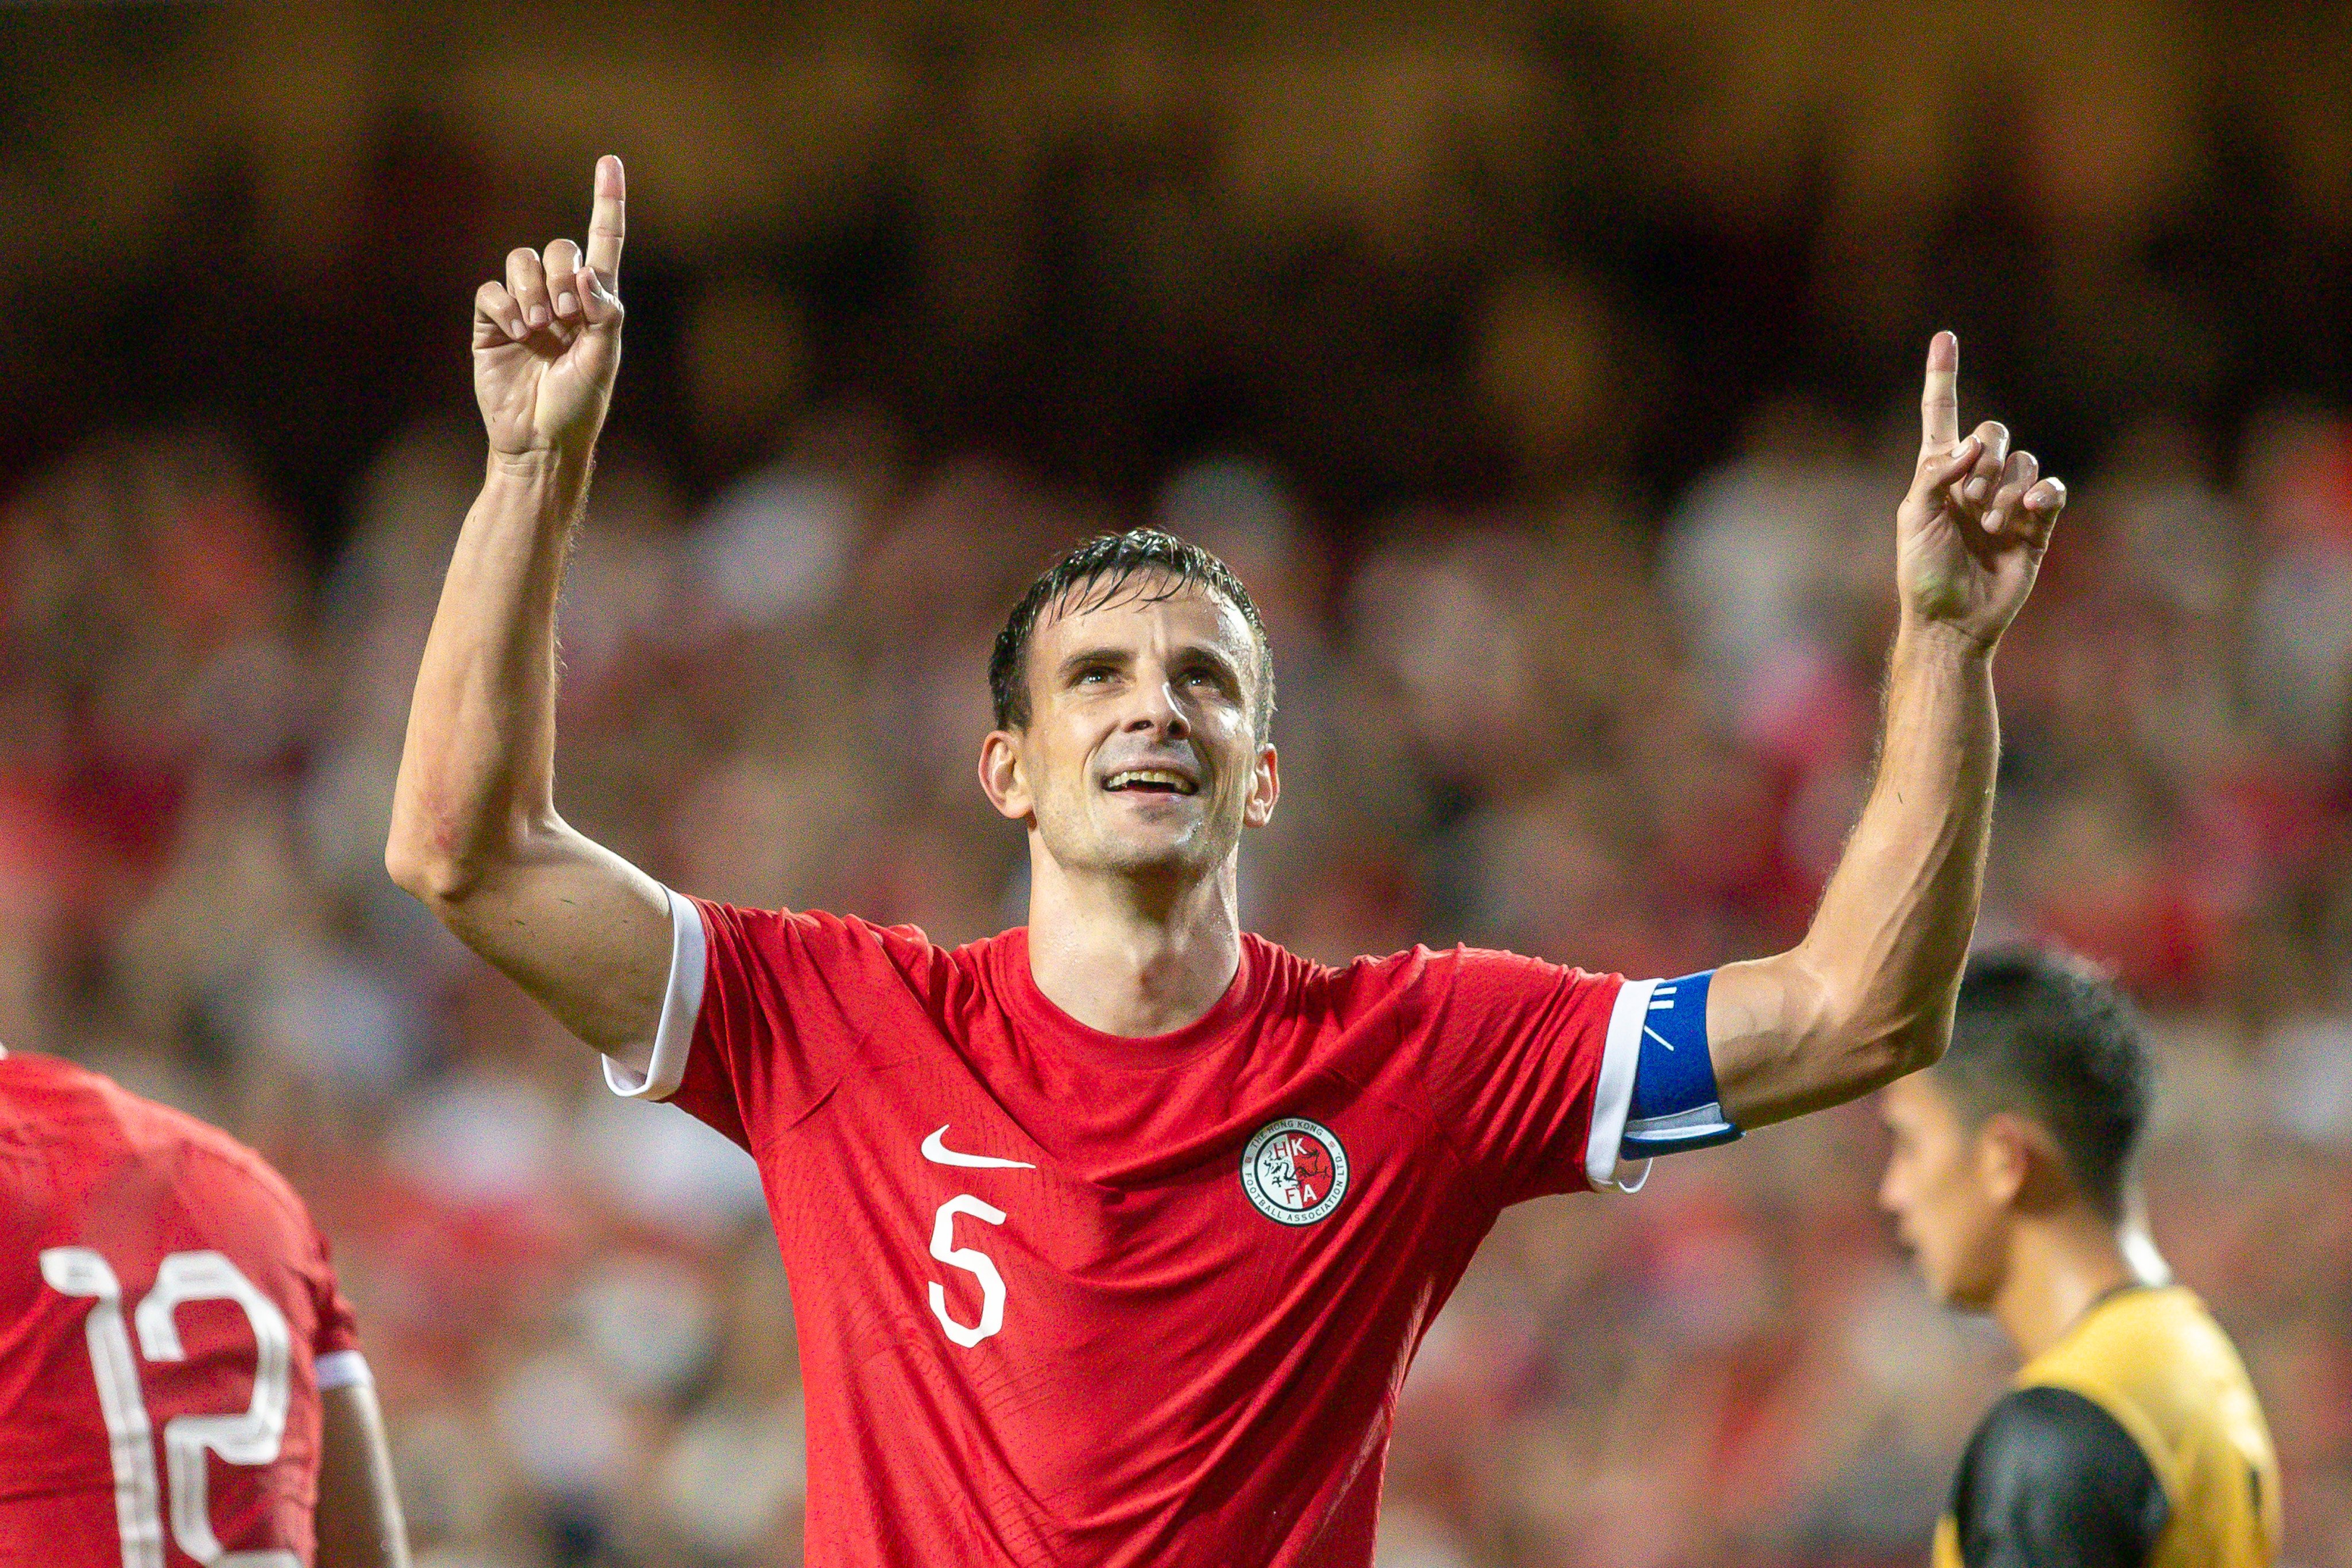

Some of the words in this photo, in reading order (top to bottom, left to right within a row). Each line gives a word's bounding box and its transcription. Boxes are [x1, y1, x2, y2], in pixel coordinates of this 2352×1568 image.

[1251, 1131, 1268, 1149] THE
[1266, 1121, 1293, 1134] HONG
[1297, 1121, 1323, 1136] KONG
[1273, 1138, 1307, 1158] HK
[1245, 1172, 1282, 1219] FOOTBALL
[1287, 1180, 1343, 1222] ASSOCIATION
[1284, 1183, 1318, 1204] FA
[928, 1194, 1006, 1348] 5
[39, 1245, 304, 1568] 12
